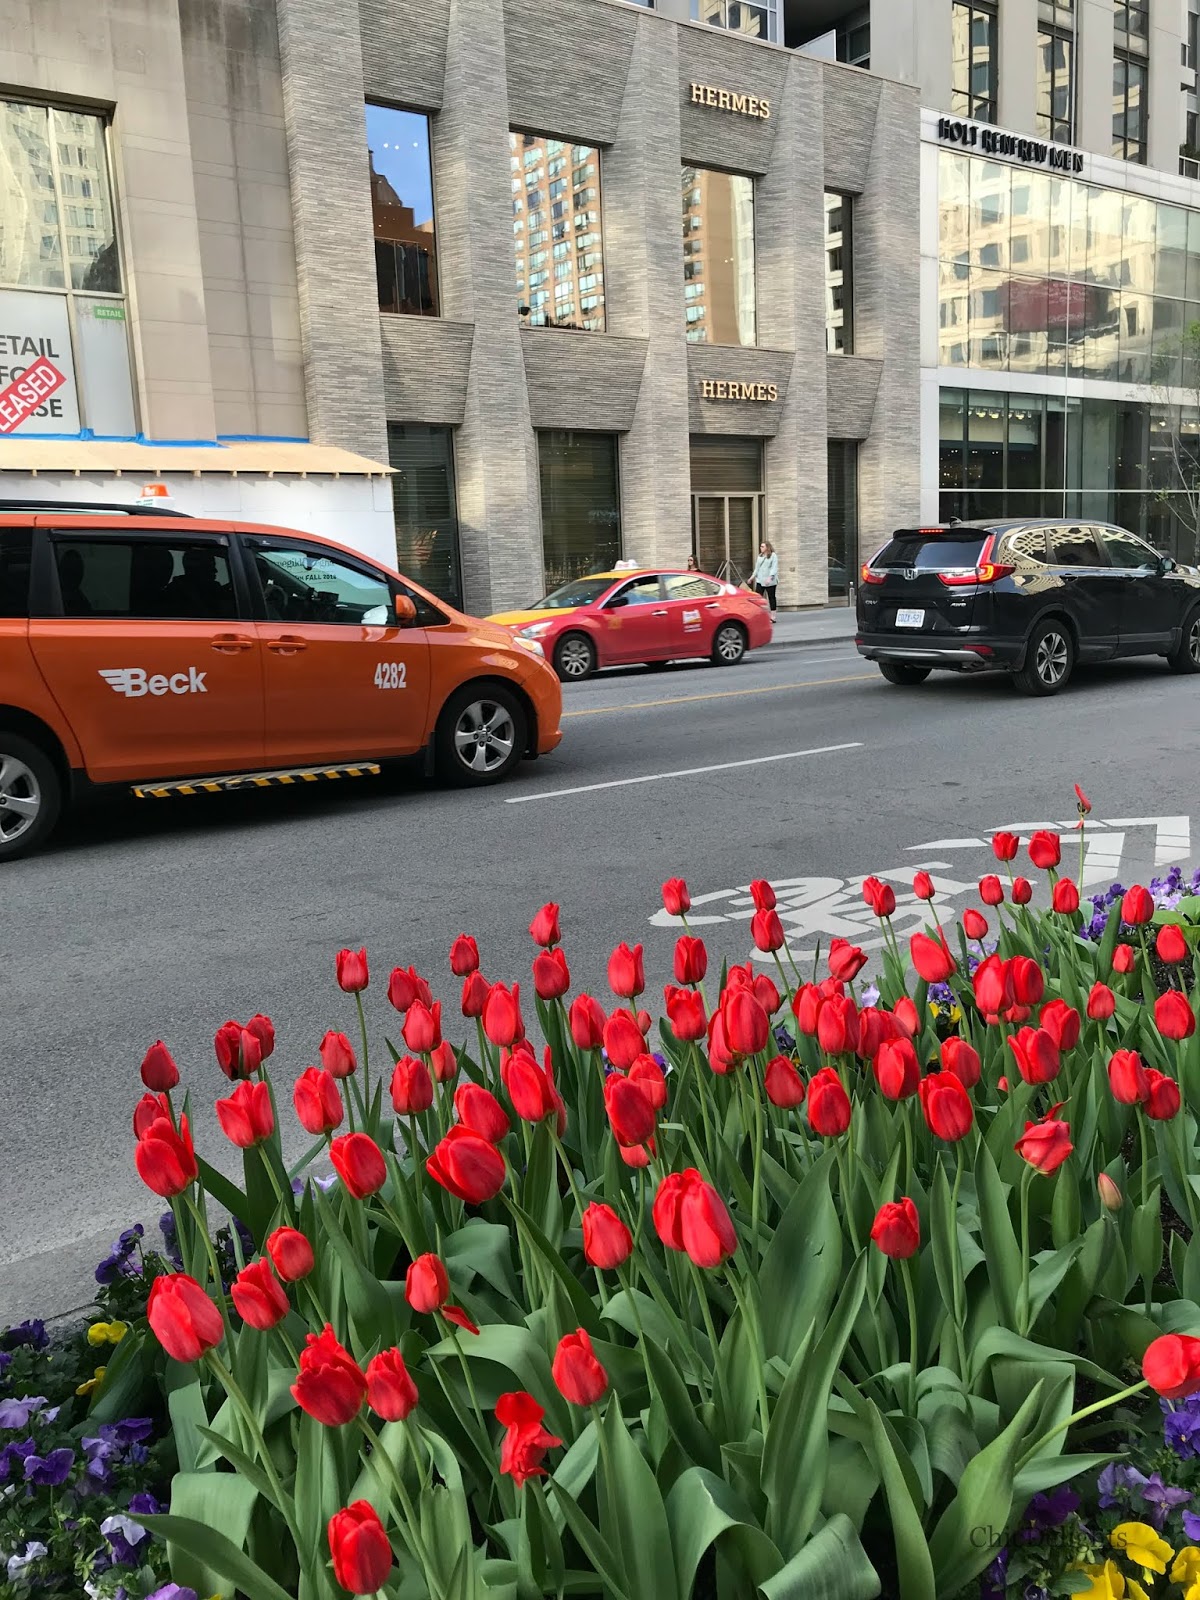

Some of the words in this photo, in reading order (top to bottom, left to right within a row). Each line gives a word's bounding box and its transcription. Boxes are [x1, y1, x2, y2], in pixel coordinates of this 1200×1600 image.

[938, 117, 979, 146] HOLT
[981, 129, 1048, 164] RENFREW
[1049, 147, 1084, 173] MEN
[96, 308, 123, 318] RETAIL
[123, 666, 208, 698] Beck
[374, 662, 407, 689] 4282
